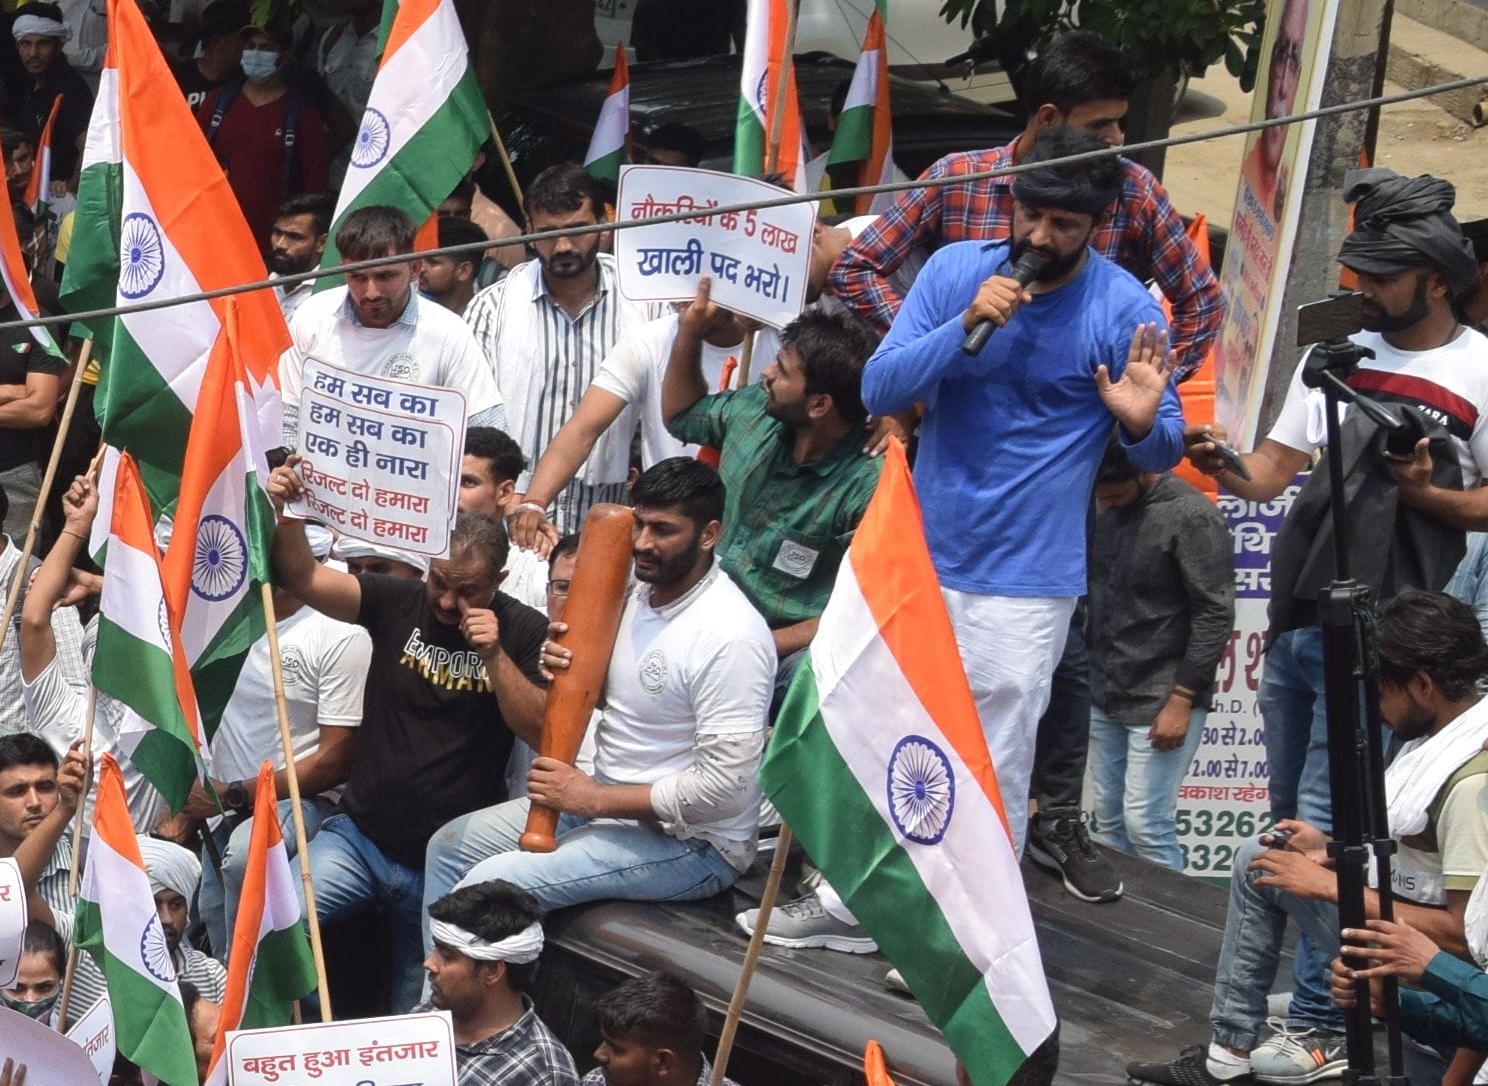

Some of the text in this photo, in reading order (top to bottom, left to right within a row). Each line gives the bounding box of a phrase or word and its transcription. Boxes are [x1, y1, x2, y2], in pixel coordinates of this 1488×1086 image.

[744, 209, 757, 236] 5
[761, 222, 798, 254] लाख
[636, 238, 704, 276] खाली
[710, 252, 741, 284] पद
[313, 370, 439, 417] हम सब का
[309, 401, 428, 448] हम सब का
[305, 431, 429, 480] एक ही नारा
[300, 460, 430, 514] रिजल्ट दो हमारा
[350, 509, 368, 531] दो
[373, 517, 428, 543] हमारा
[242, 1040, 439, 1083] बहुत हुआ इंतजार
